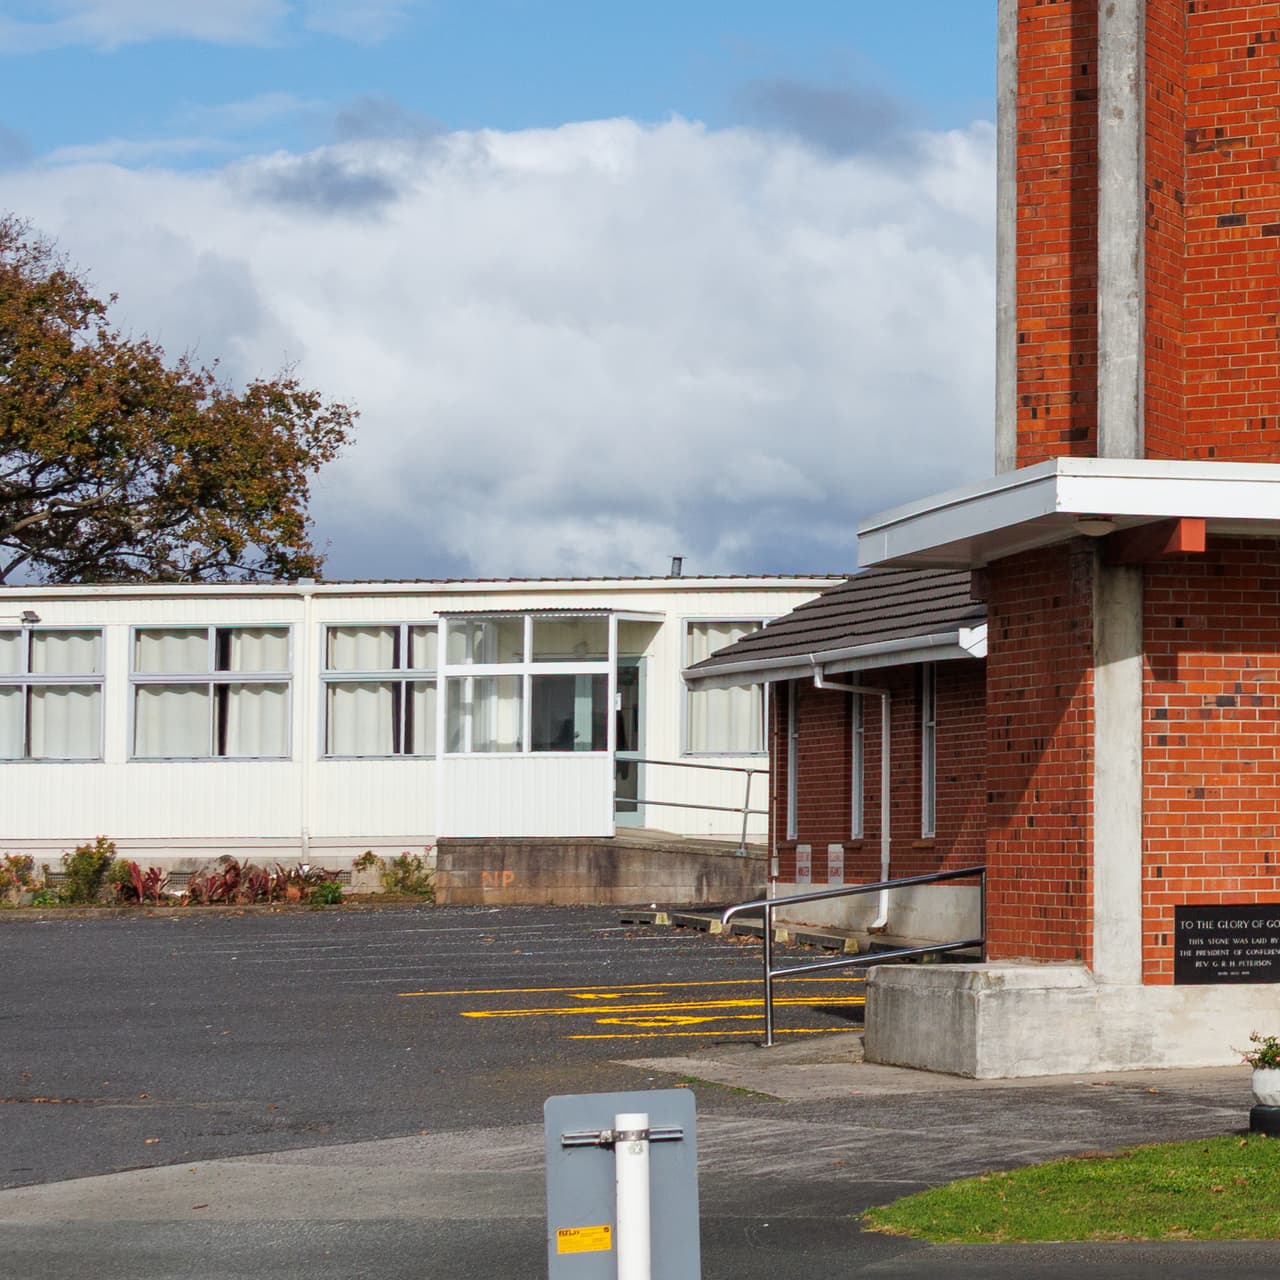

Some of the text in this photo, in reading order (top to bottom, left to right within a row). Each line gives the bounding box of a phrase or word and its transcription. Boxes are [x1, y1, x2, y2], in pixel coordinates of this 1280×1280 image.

[1181, 920, 1193, 929] TO
[1196, 920, 1215, 929] THE
[1217, 920, 1249, 929] GLORY
[1251, 919, 1265, 929] OF
